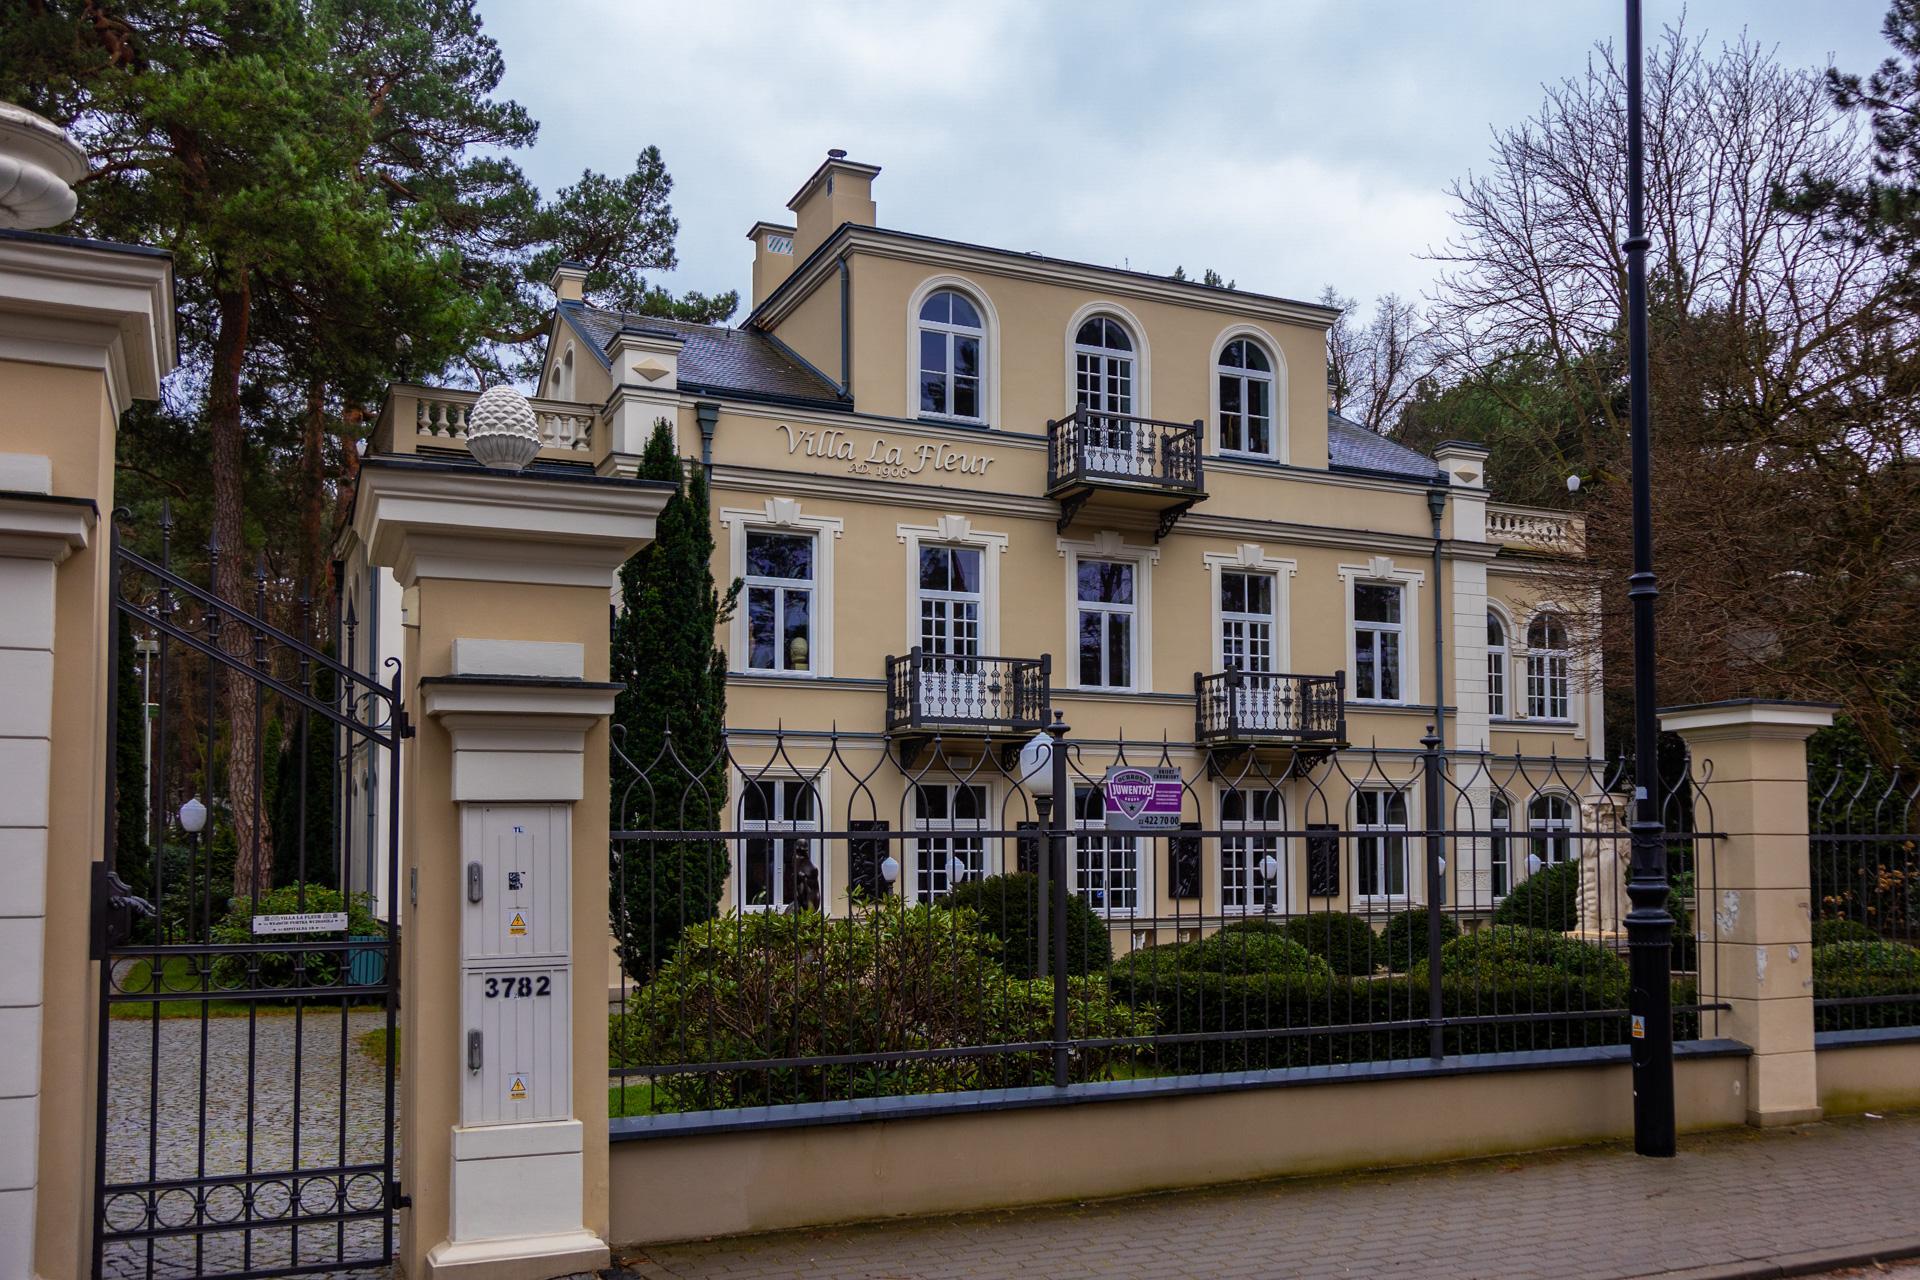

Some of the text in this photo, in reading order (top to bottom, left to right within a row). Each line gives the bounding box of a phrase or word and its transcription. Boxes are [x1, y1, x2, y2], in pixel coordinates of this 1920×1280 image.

[776, 424, 995, 476] Villa La Fleur
[875, 465, 908, 478] 1906
[1113, 785, 1152, 796] JUWENTUS
[1144, 816, 1158, 825] 422
[1159, 816, 1169, 825] 70
[1170, 816, 1179, 825] 00
[485, 976, 551, 999] 3782
